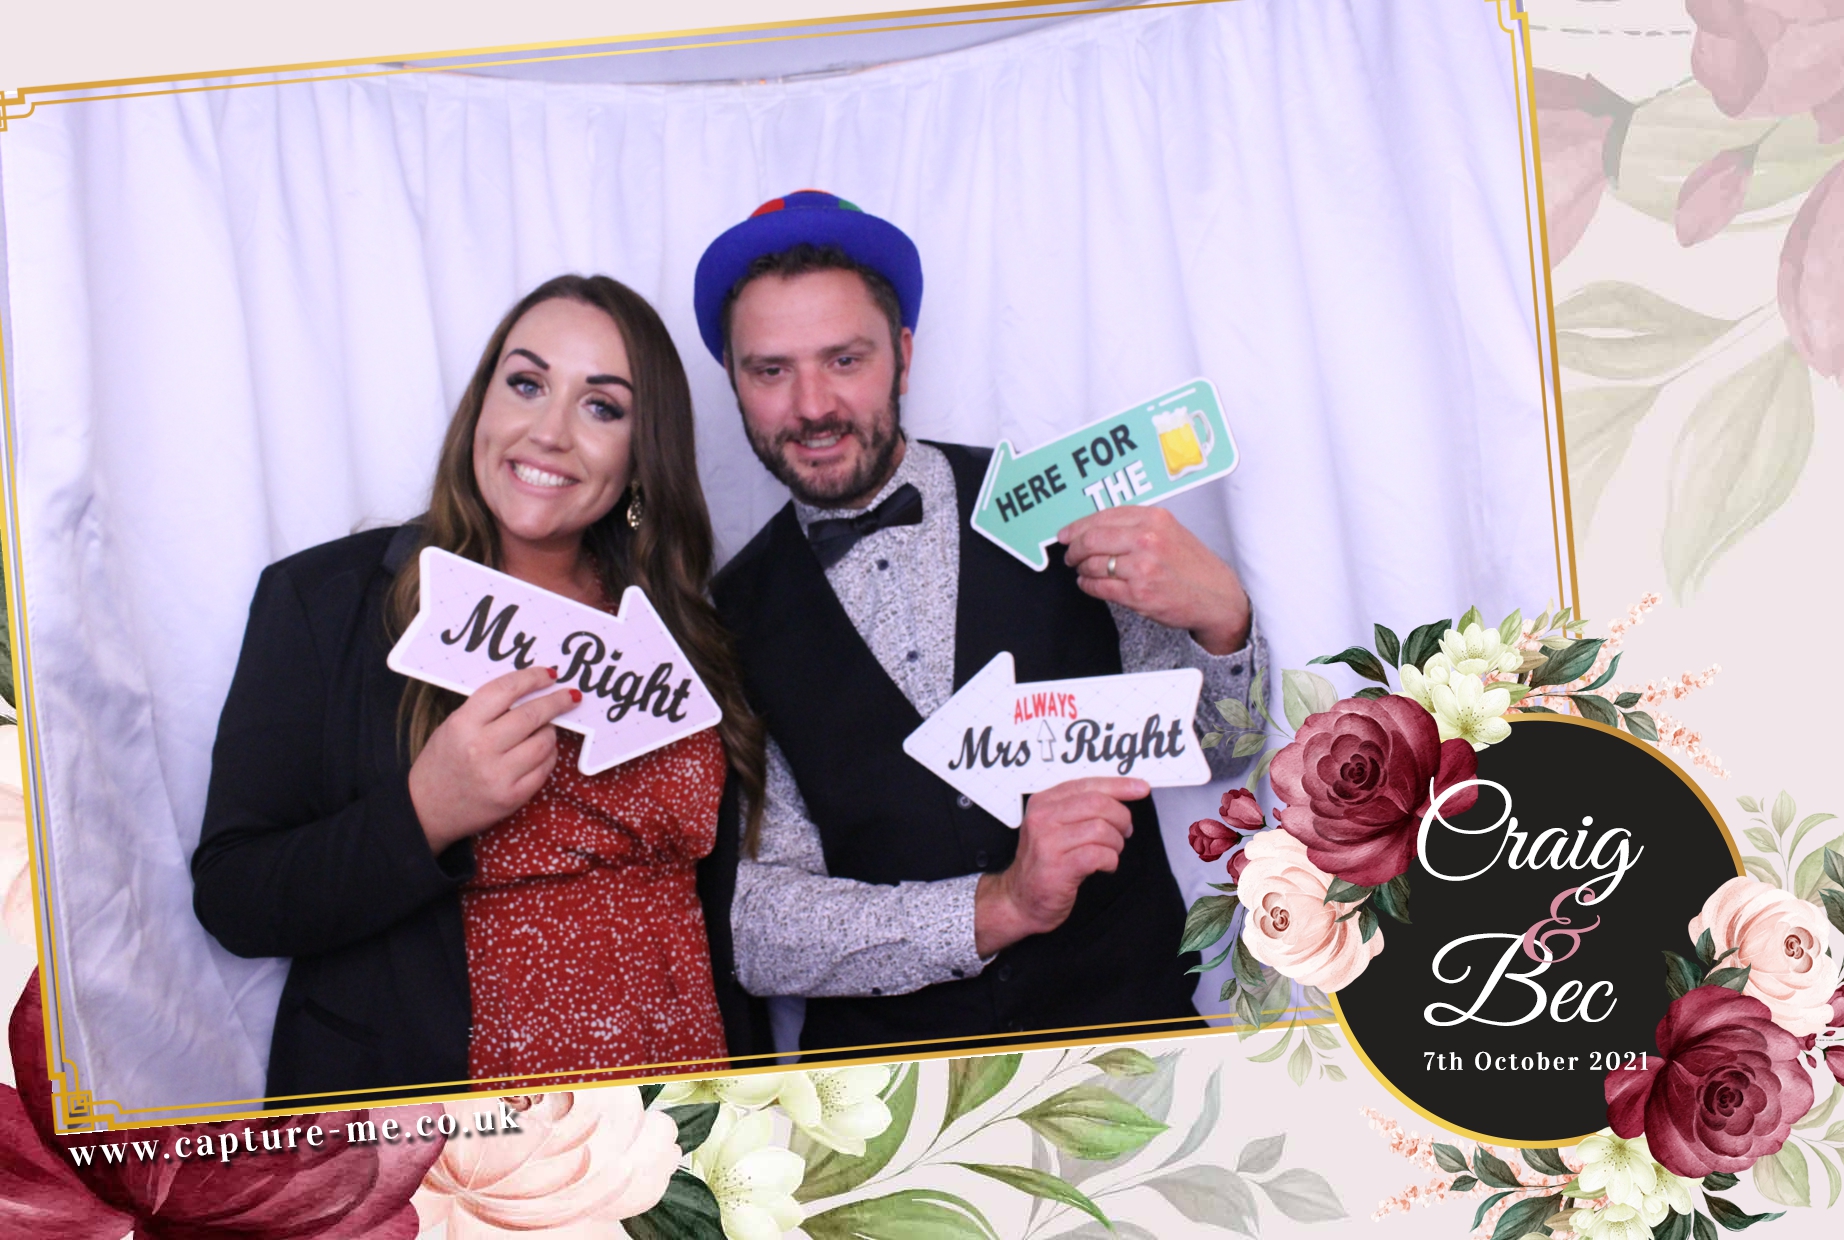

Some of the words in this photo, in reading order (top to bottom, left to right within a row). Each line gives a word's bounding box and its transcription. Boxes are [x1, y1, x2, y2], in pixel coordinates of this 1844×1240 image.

[995, 464, 1067, 523] HERE
[1071, 424, 1138, 479] FOR
[1082, 460, 1153, 512] THE
[441, 595, 537, 670] Mr
[553, 631, 692, 723] Right
[1014, 691, 1078, 725] ALWAYS
[948, 726, 1031, 770] Mrs
[1061, 714, 1186, 775] Right
